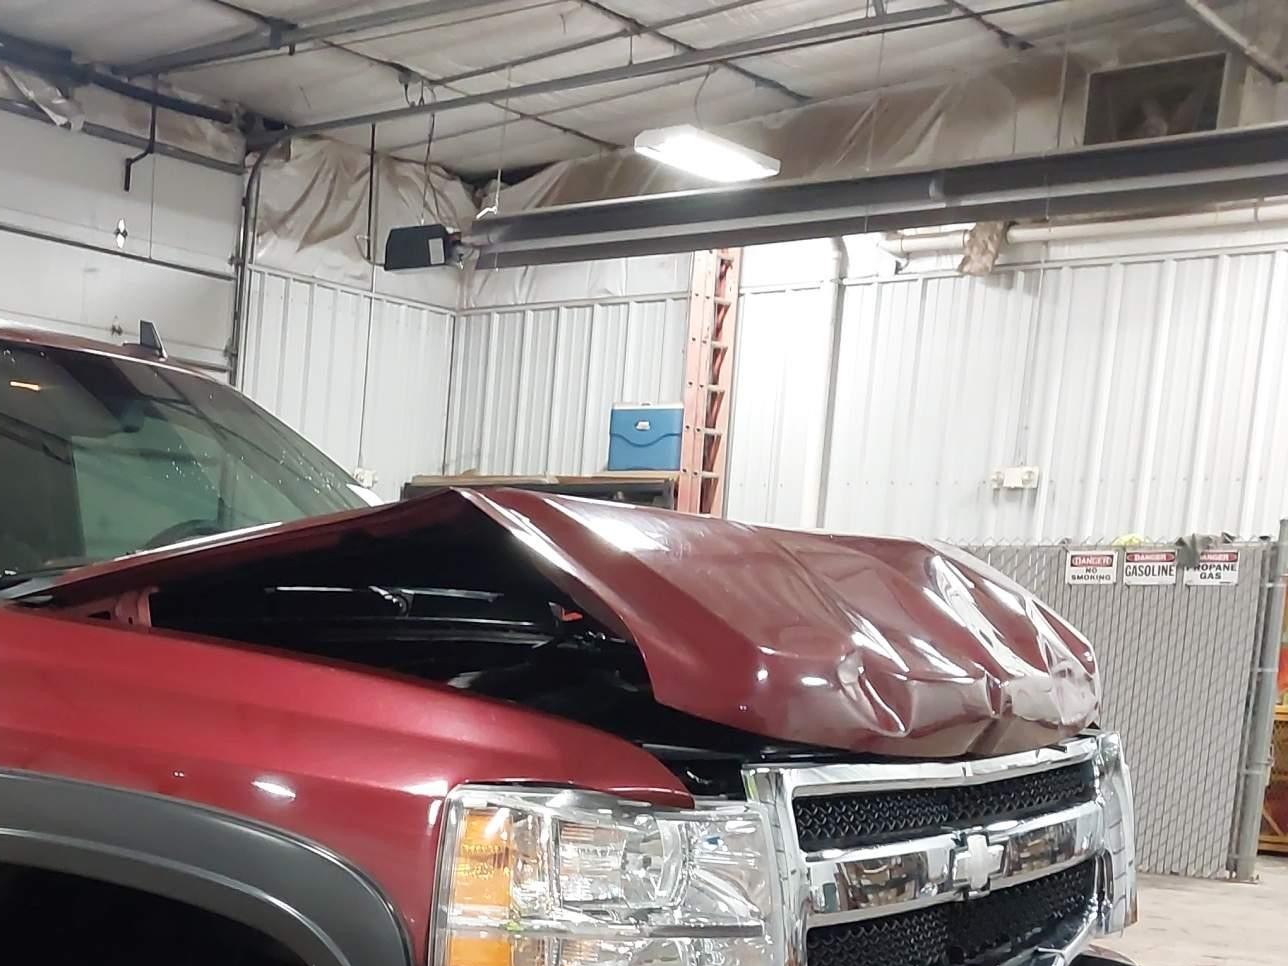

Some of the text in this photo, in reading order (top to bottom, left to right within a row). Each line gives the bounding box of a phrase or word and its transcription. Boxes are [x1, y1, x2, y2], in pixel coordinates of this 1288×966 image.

[1074, 556, 1111, 566] DANGER
[1134, 553, 1167, 561] DANGER
[1125, 564, 1175, 577] GASOLINE
[1199, 571, 1222, 580] GAS
